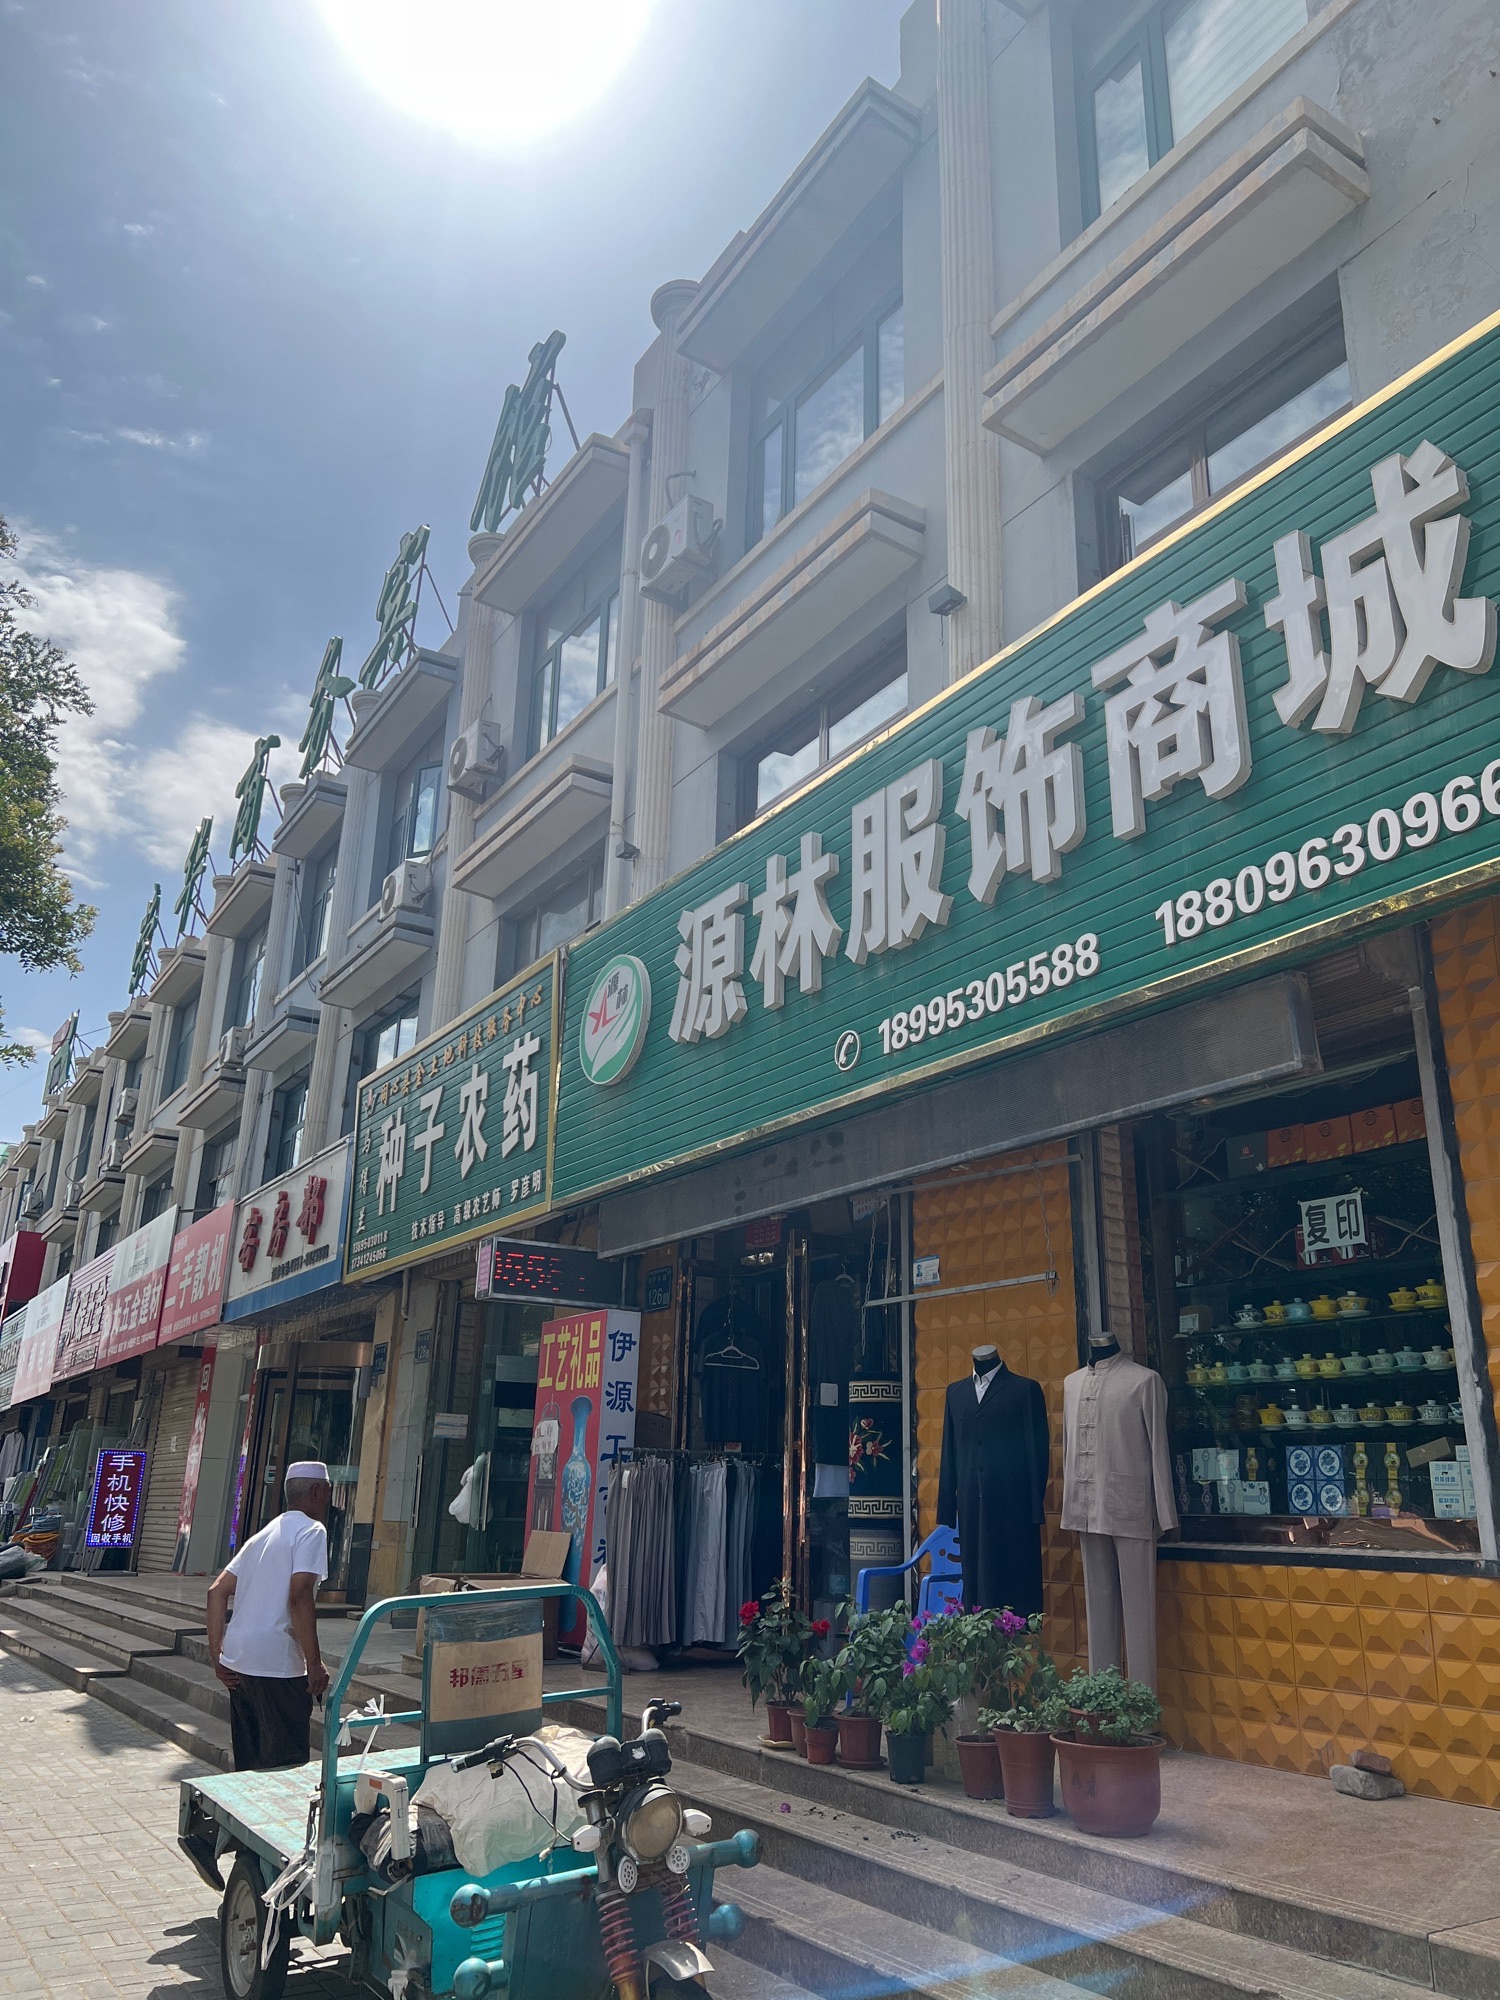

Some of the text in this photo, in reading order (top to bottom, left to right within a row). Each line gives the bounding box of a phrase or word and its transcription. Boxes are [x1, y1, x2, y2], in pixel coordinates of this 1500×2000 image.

[668, 440, 1497, 1044] 源林服饰商城
[607, 971, 629, 1010] 源林
[877, 932, 1101, 1056] 18995305588
[380, 984, 544, 1105] 同心县金土地科技服务中心
[375, 1031, 541, 1216] 种子农药
[410, 1168, 542, 1241] 技术指导 高级农艺师 罗彦明
[1305, 1198, 1360, 1247] 复印
[164, 1232, 226, 1311] 二手靓机
[538, 1320, 602, 1391] 工艺礼品
[101, 1454, 136, 1533] 手机快修
[91, 1533, 132, 1544] 回收手机
